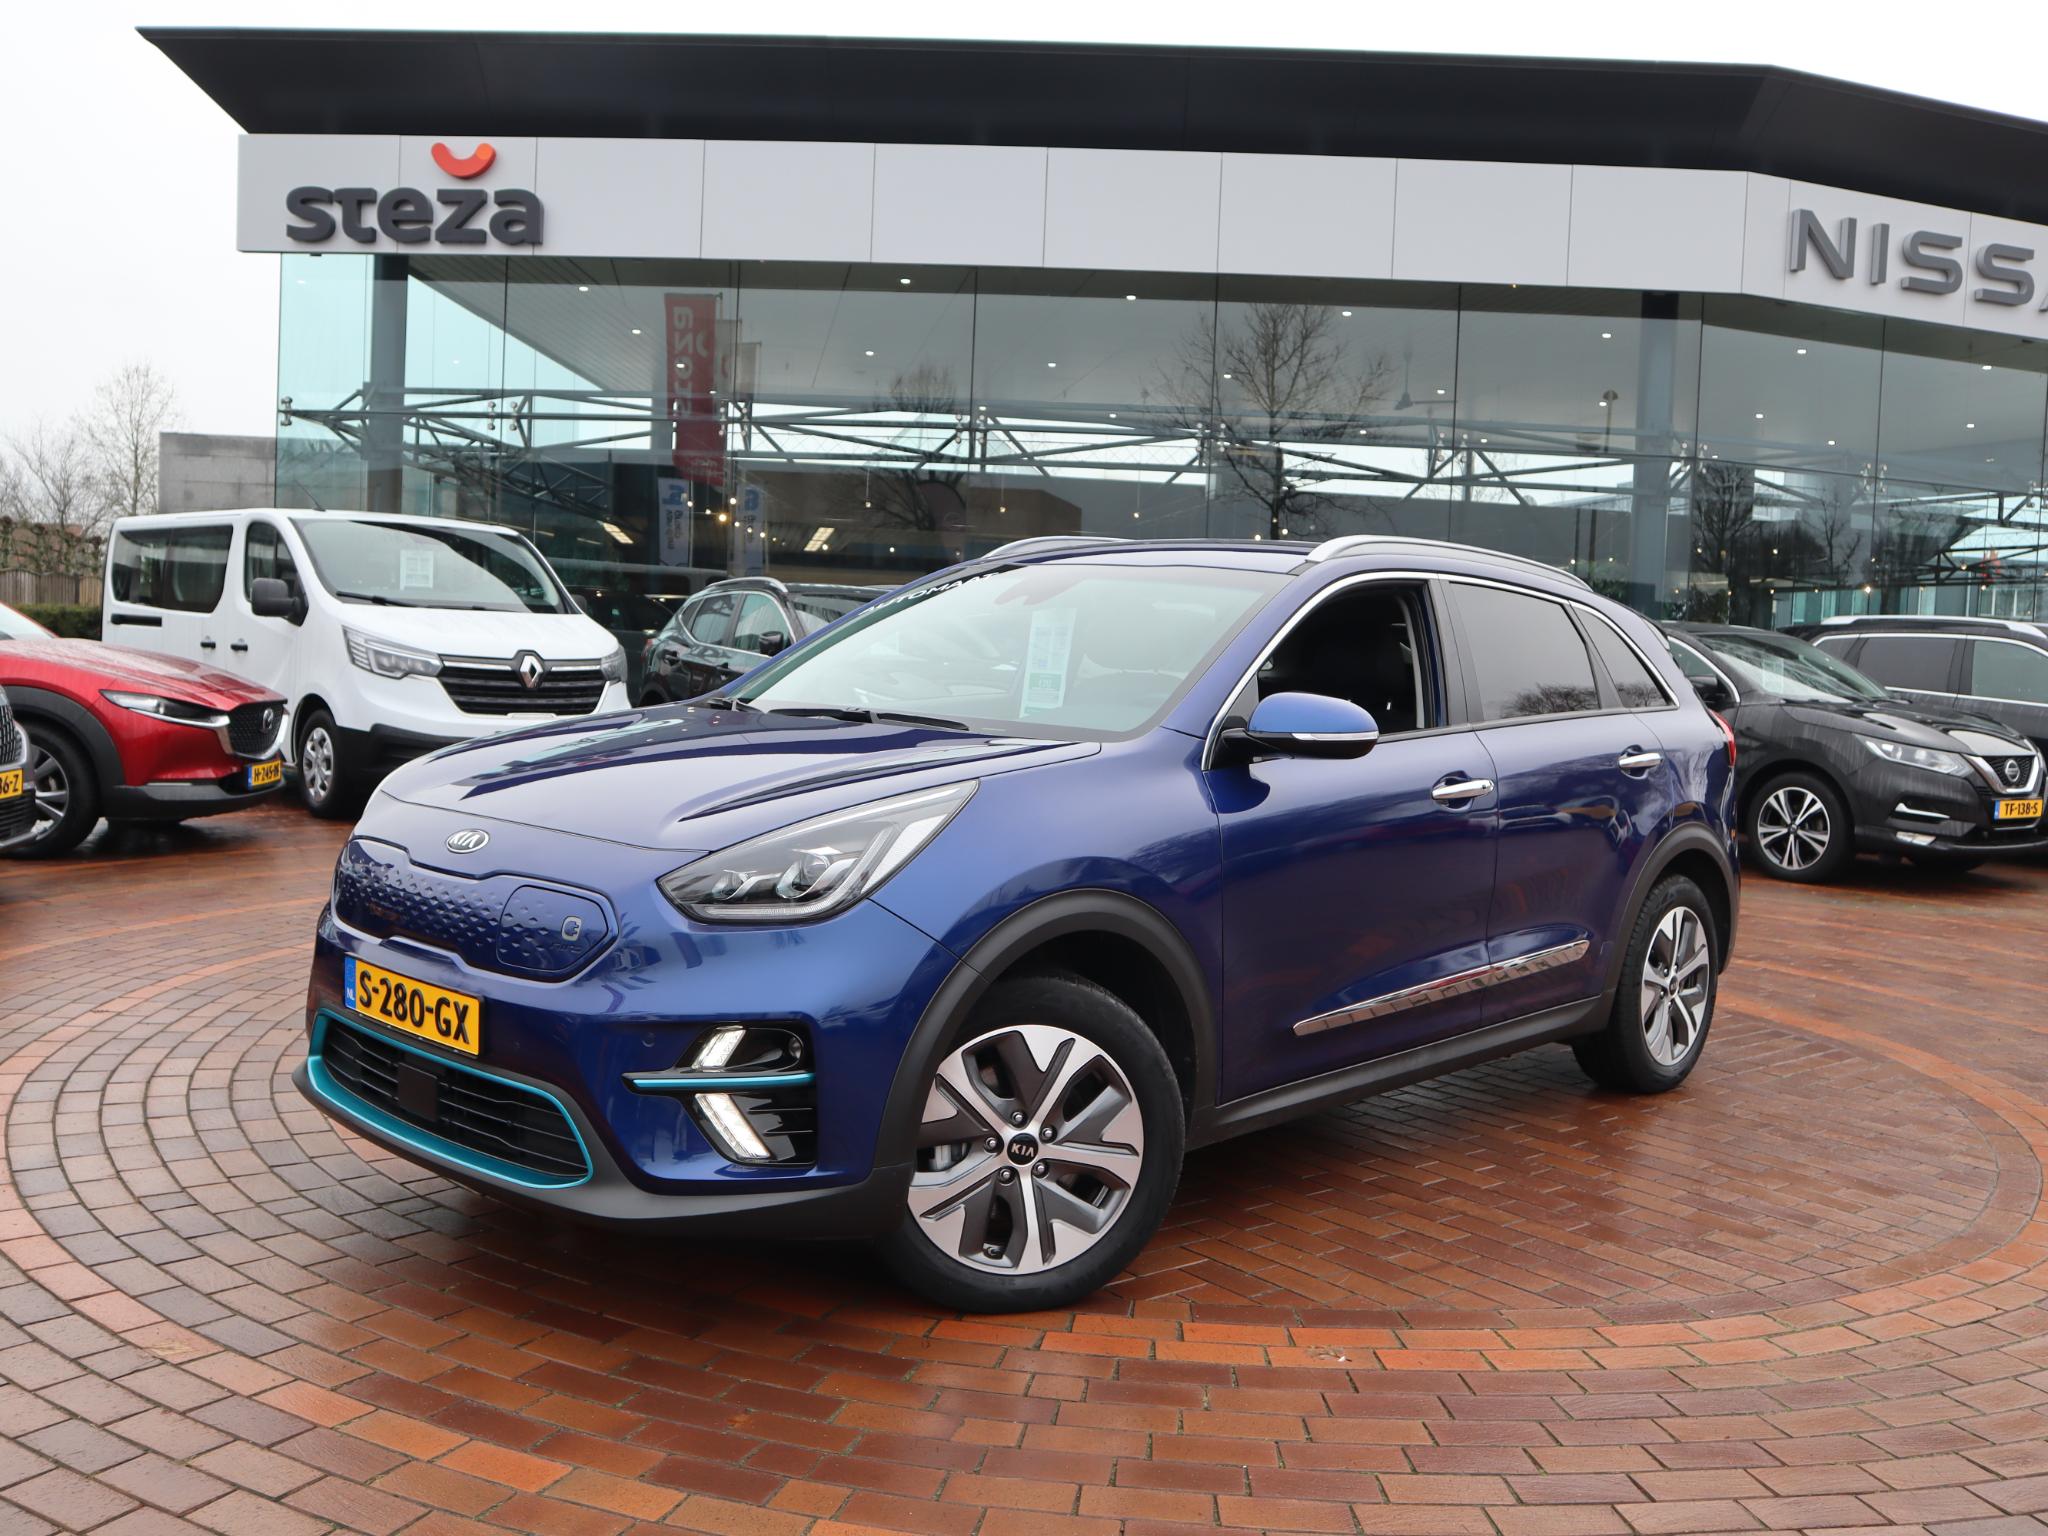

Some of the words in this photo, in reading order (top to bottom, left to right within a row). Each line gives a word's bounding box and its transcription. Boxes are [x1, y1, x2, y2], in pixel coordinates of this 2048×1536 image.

[286, 186, 545, 246] steza
[1790, 208, 2048, 313] NISS
[448, 831, 482, 849] KIA
[359, 969, 470, 1045] S-280-GX
[1010, 1143, 1034, 1158] KIA
